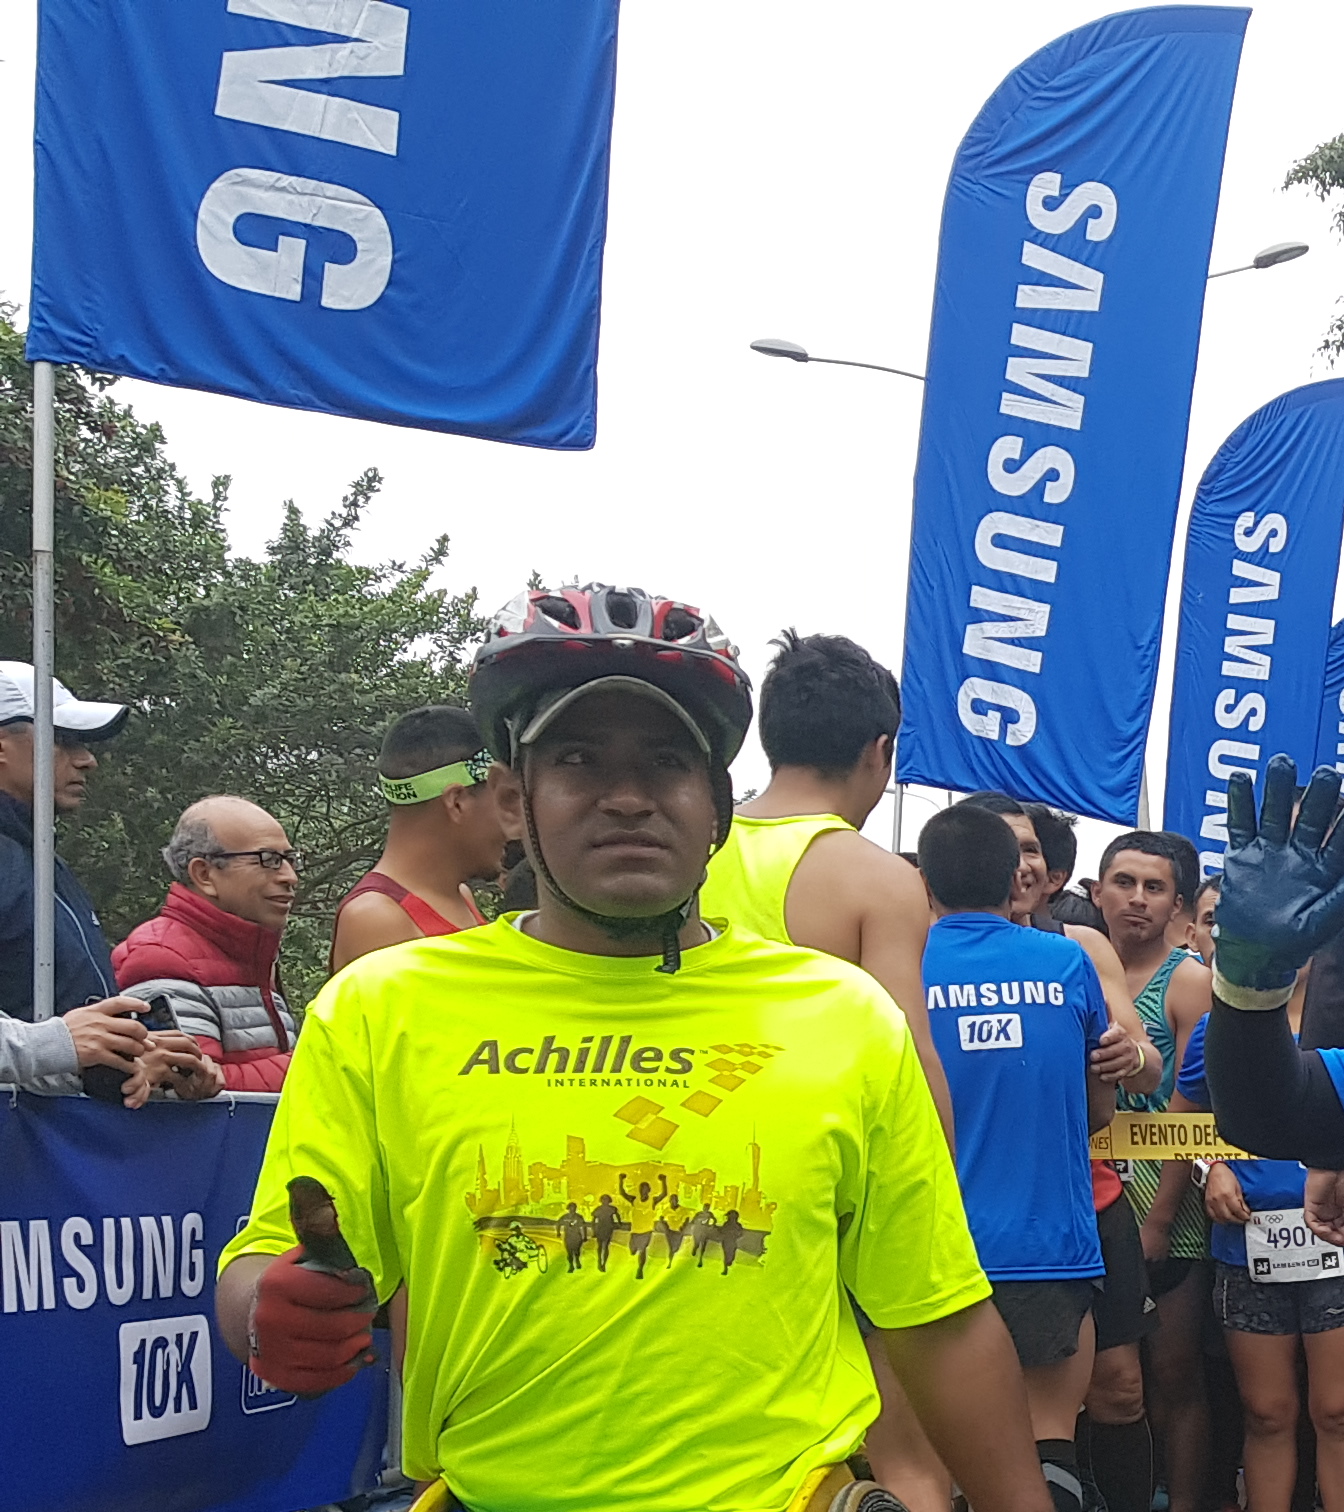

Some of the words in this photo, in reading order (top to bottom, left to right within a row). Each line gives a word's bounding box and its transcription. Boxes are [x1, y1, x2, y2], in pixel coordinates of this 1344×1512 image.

[197, 0, 410, 311] NG
[957, 170, 1119, 749] SAMSUNG
[457, 1034, 696, 1076] Achilles
[967, 1018, 1013, 1044] 10K
[547, 1078, 690, 1088] INTERNATIONAL
[1129, 1123, 1188, 1146] EVENTO
[0, 1212, 205, 1314] MSUNG
[133, 1330, 200, 1421] 10K
